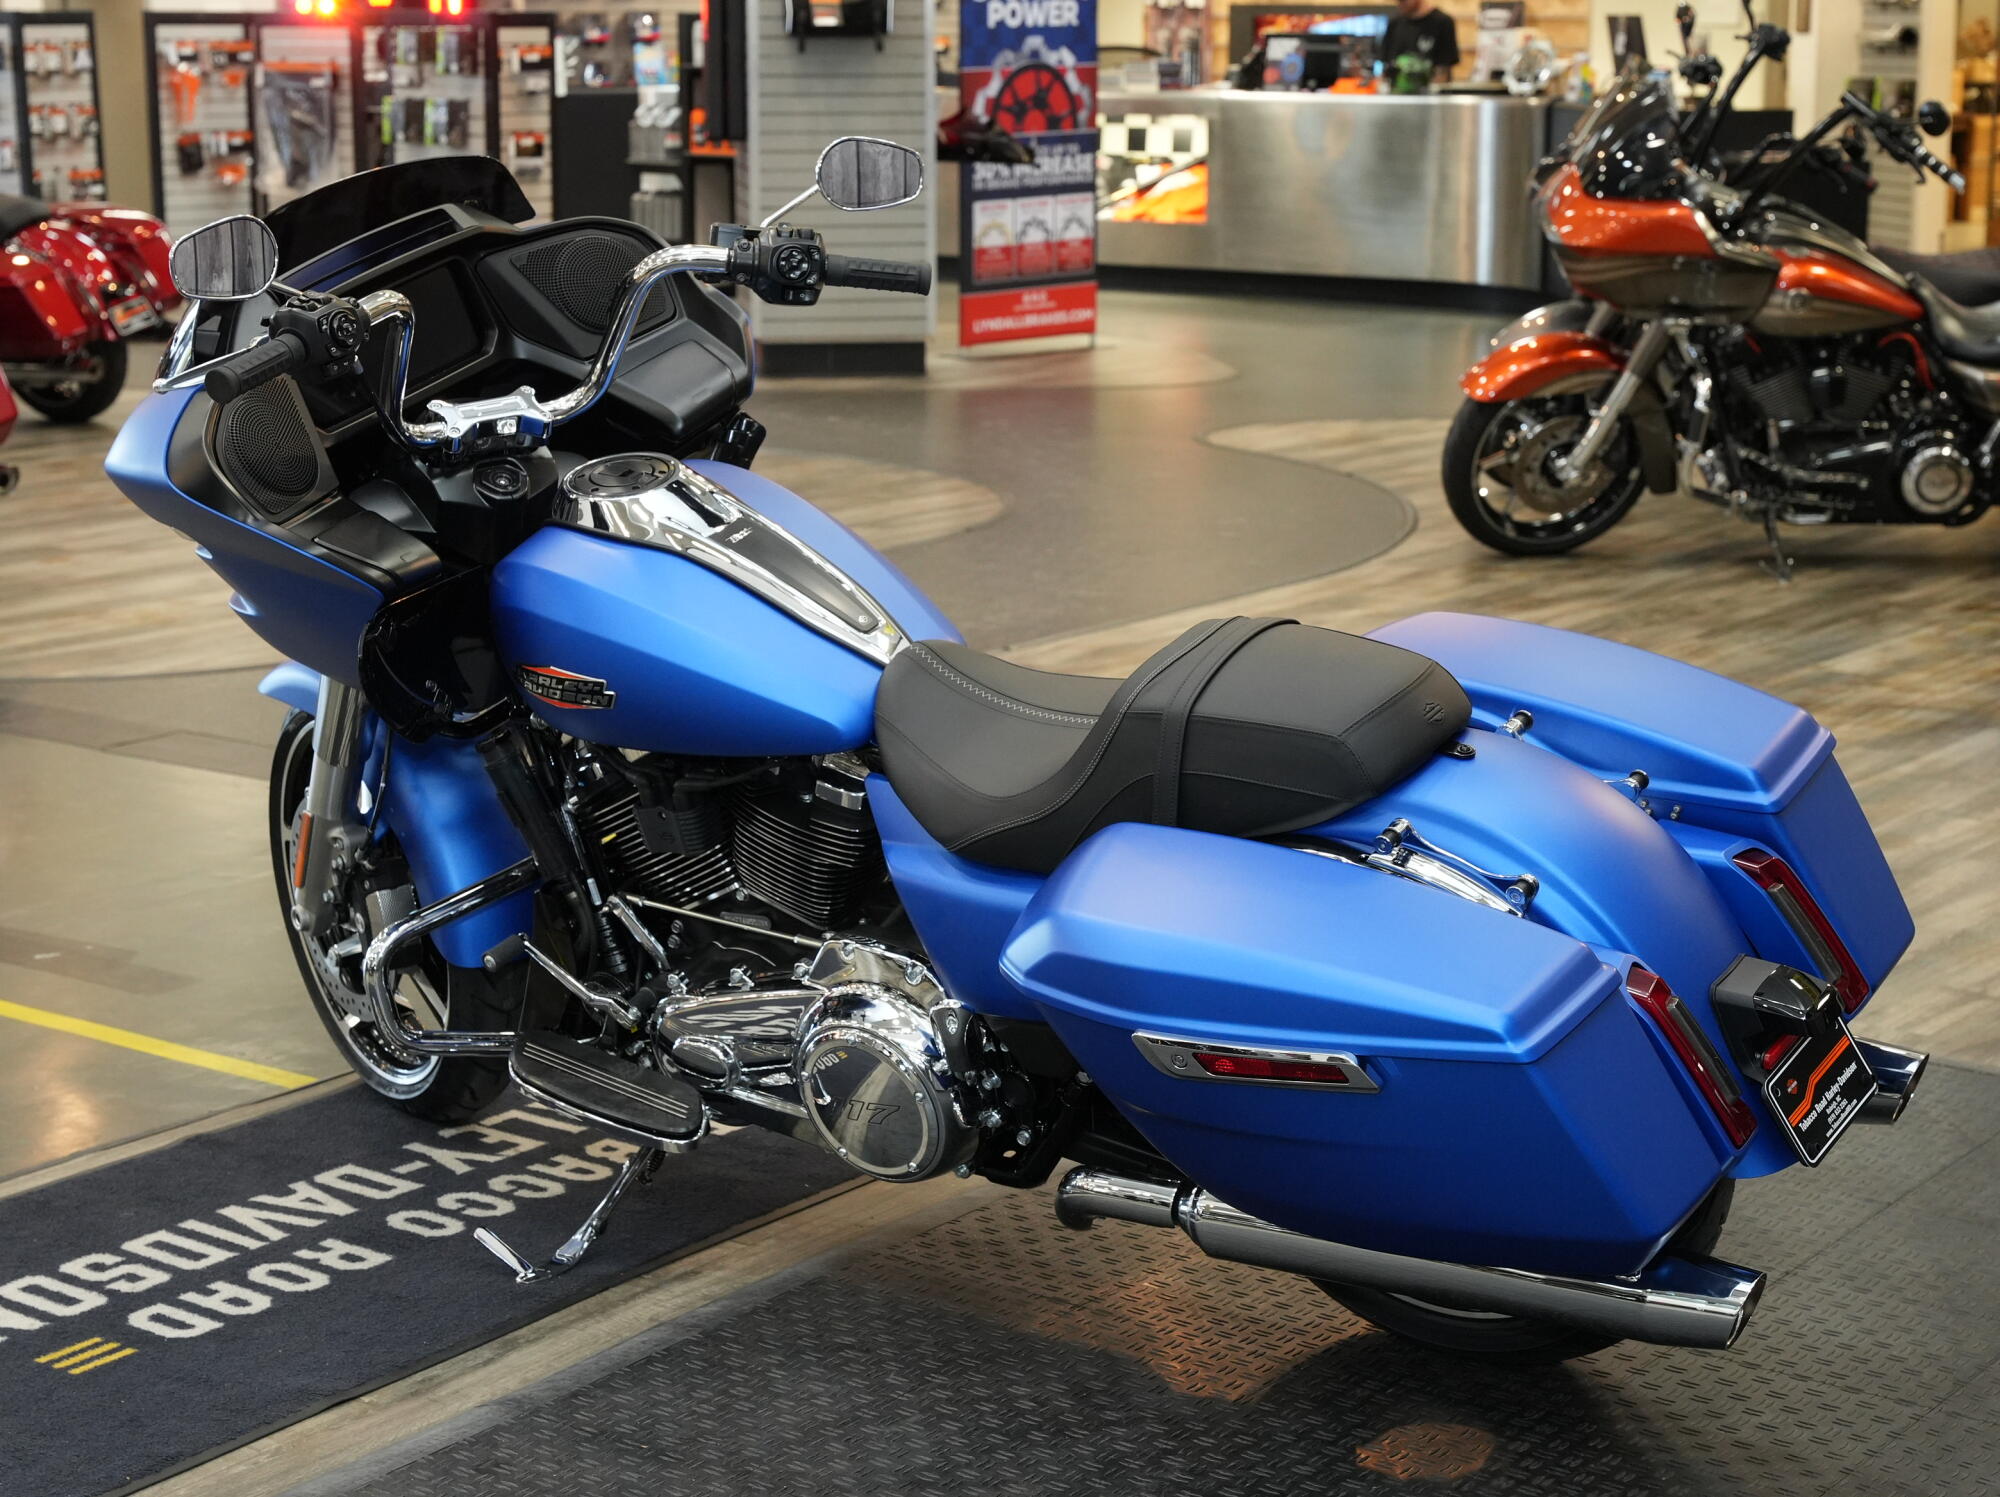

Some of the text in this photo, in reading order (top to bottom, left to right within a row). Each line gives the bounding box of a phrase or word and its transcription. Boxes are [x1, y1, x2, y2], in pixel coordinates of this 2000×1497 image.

[986, 0, 1080, 29] POWER
[1798, 1061, 1858, 1132] Tobacco Road Harley-Davidson
[127, 1238, 394, 1338] ROAD
